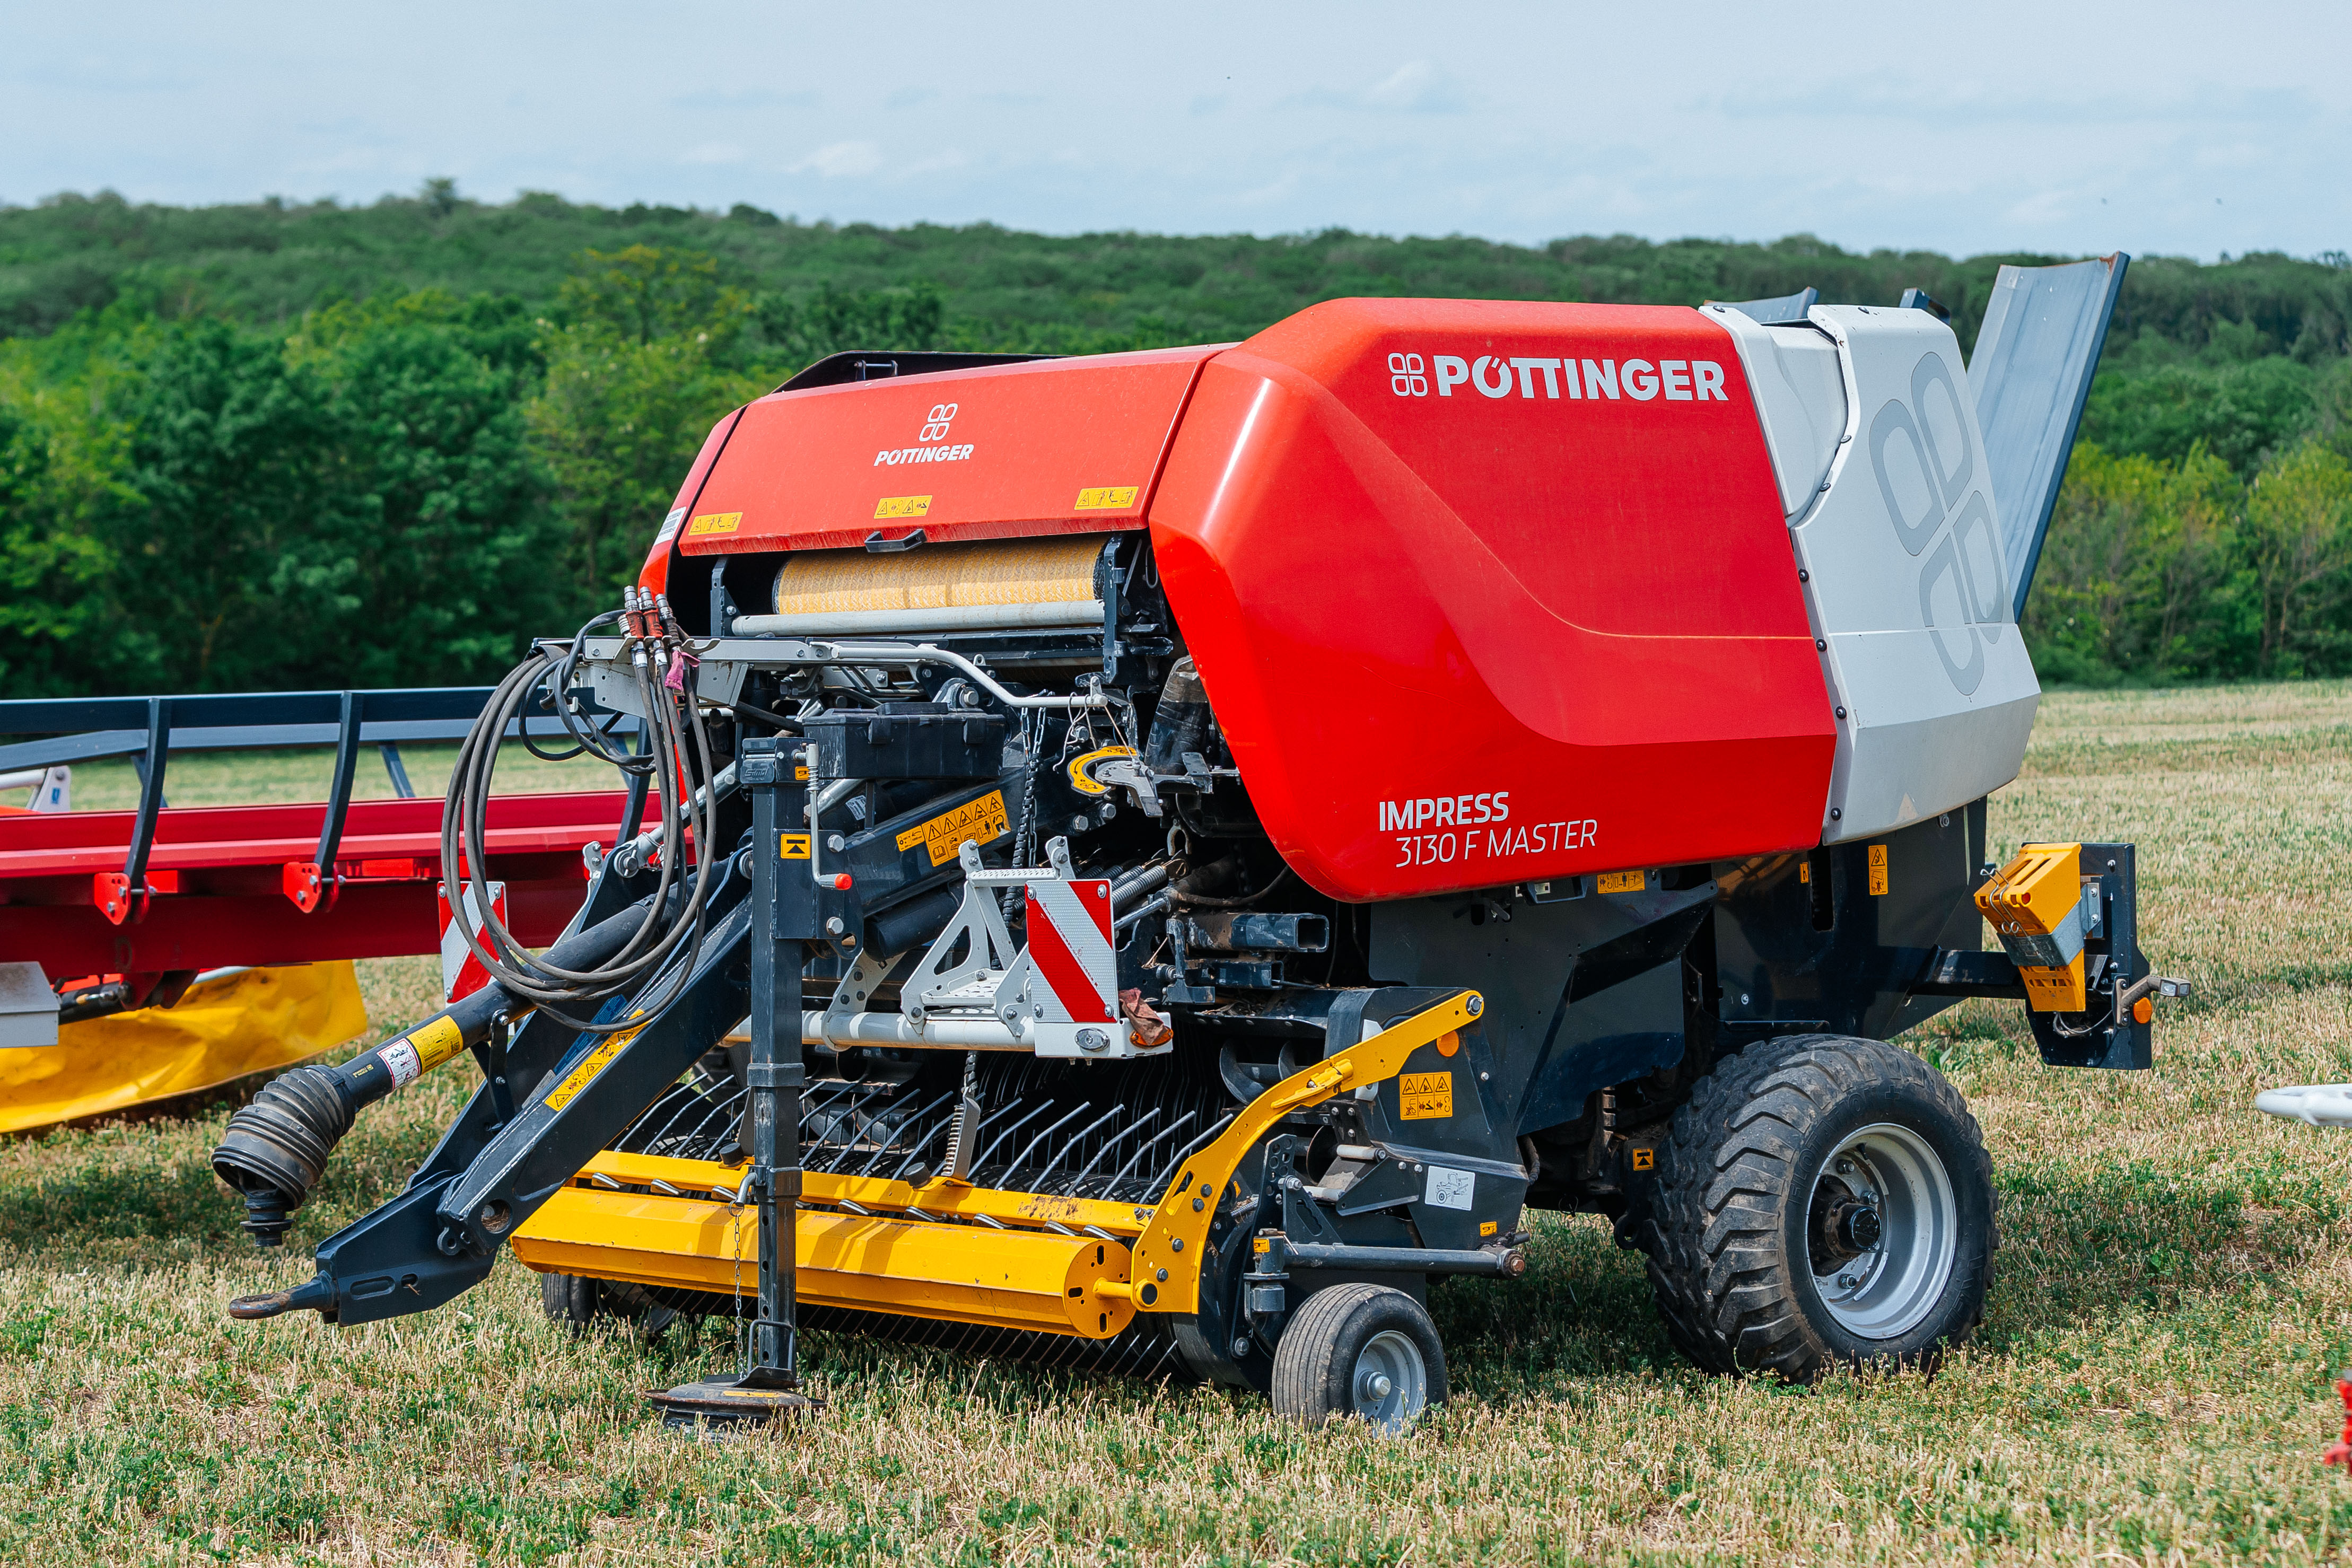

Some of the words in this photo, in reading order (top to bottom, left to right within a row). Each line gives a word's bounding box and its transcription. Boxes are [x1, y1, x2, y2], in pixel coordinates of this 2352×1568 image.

[1433, 355, 1729, 401] PÖTTINGER
[1379, 792, 1509, 831] IMPRESS
[1396, 833, 1457, 868] 3130
[1464, 830, 1481, 860] F
[1487, 819, 1597, 858] MASTER
